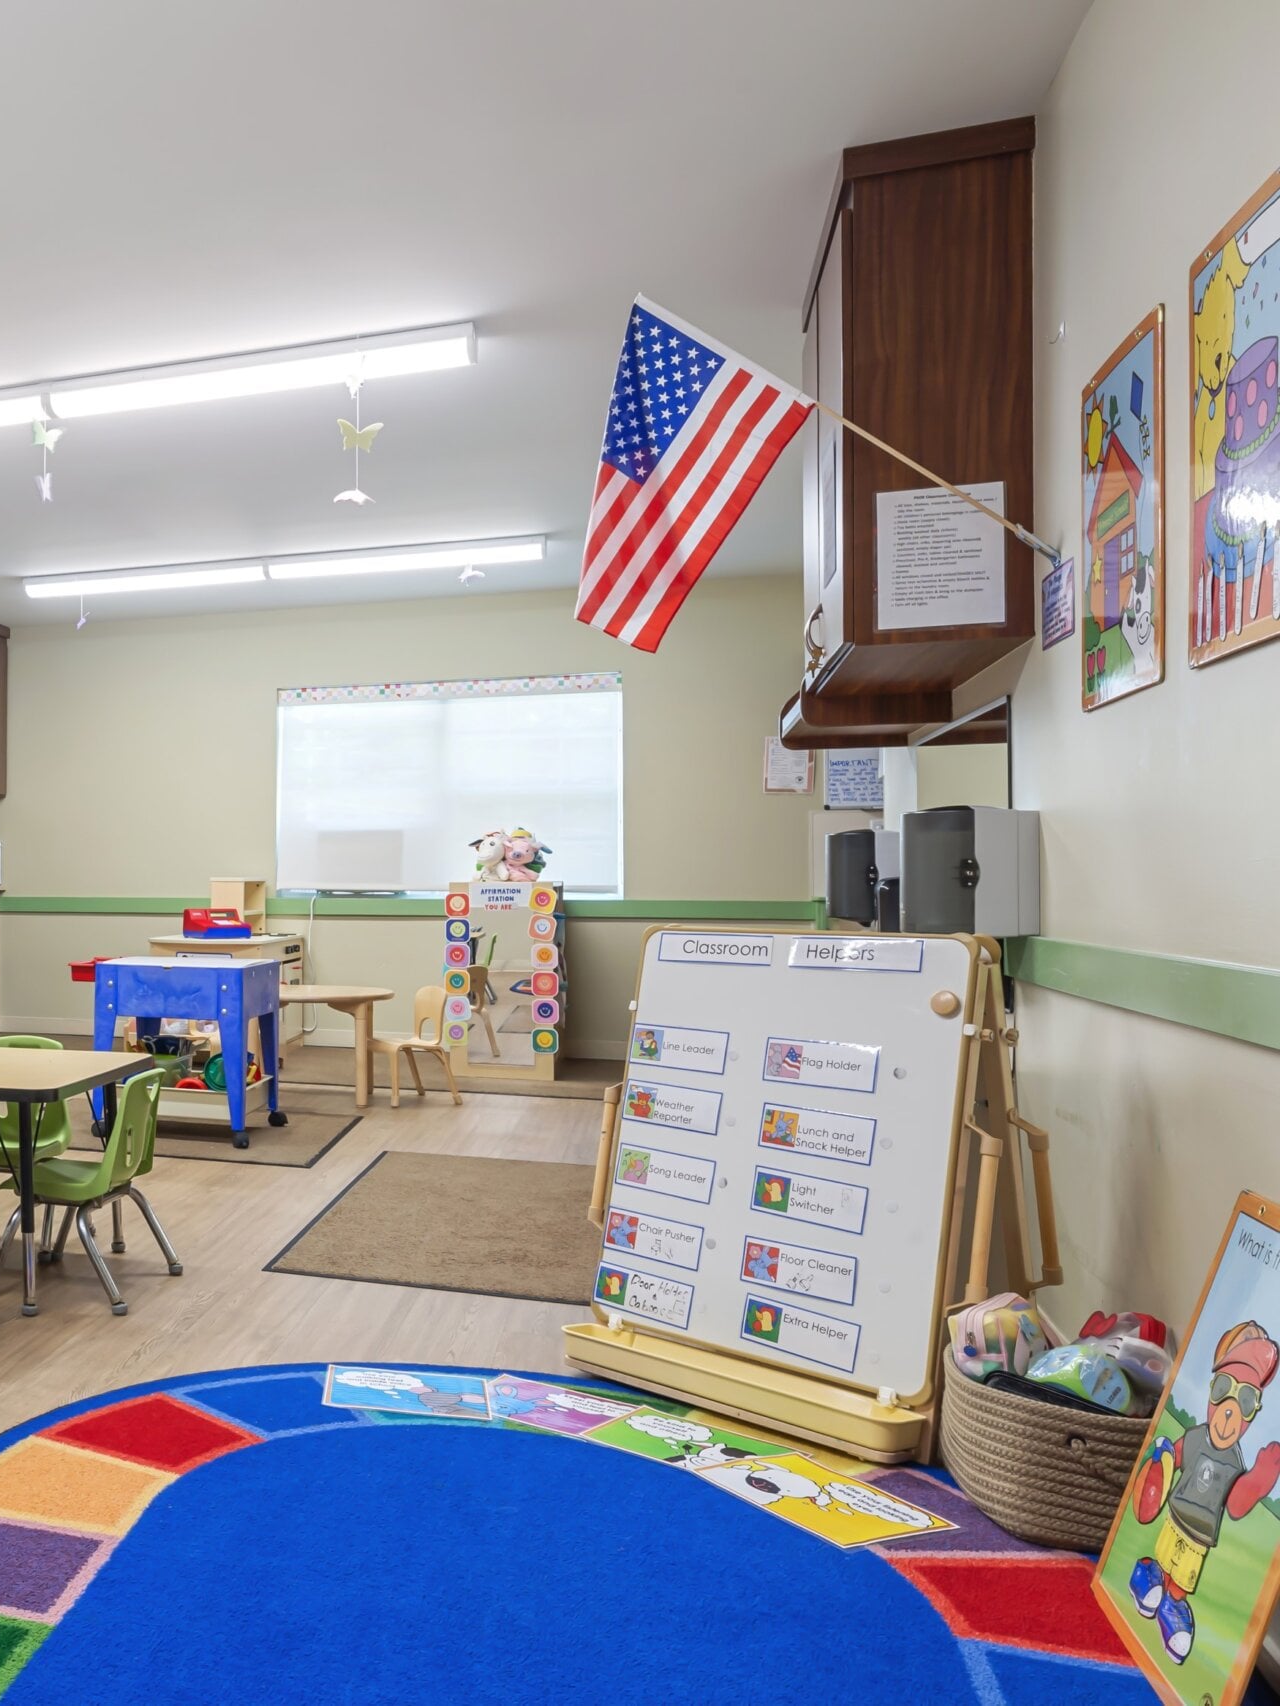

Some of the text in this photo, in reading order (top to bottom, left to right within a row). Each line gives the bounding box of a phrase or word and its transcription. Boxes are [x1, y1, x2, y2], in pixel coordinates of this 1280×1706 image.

[682, 940, 768, 958] Classroom
[663, 1041, 715, 1055] Line Leader
[801, 1056, 862, 1072] Flag Holder
[656, 1099, 694, 1112] Weather
[653, 1110, 692, 1124] Reporter
[798, 1125, 855, 1142] Lunch and
[796, 1138, 866, 1158] Snack Helper
[649, 1164, 706, 1184] Song Leader
[791, 1183, 817, 1196] Light
[789, 1197, 835, 1216] Switcher
[639, 1222, 695, 1243] Chair Pusher
[1238, 1228, 1265, 1260] What
[1263, 1243, 1272, 1265] is
[780, 1253, 852, 1277] Floor Cleaner
[630, 1273, 655, 1290] Door
[783, 1313, 848, 1341] Extra Helper
[857, 1499, 876, 1508] and
[863, 1495, 881, 1505] your
[883, 1504, 919, 1521] listening
